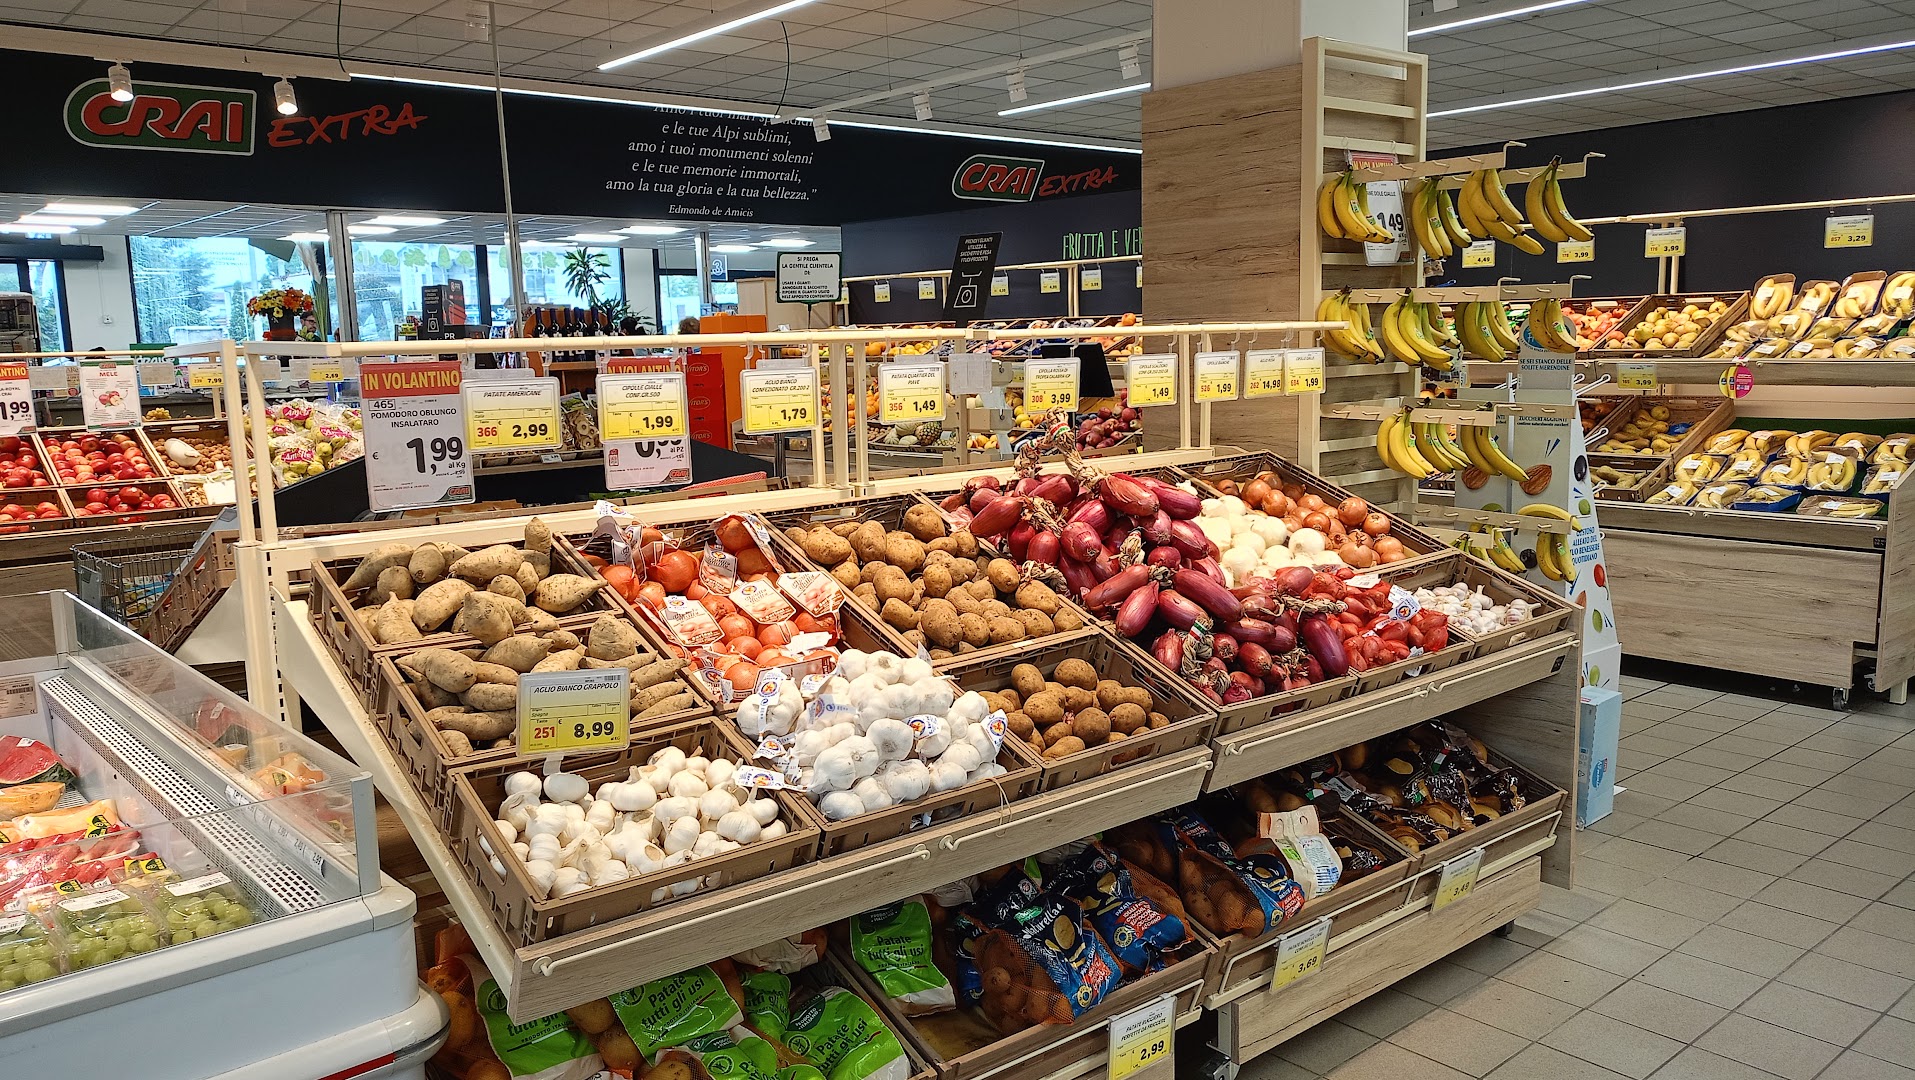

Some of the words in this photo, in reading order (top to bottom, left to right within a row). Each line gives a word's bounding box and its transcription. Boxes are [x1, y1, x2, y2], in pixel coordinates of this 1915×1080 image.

[80, 92, 244, 143] CRAI
[267, 102, 428, 148] EXTRA
[662, 124, 670, 134] e
[673, 121, 685, 135] le
[688, 125, 709, 136] tue
[712, 124, 740, 142] Alpi
[743, 127, 792, 146] sublimi,
[628, 143, 656, 153] amo
[669, 142, 695, 155] tuoi
[699, 145, 770, 161] monumenti
[772, 150, 814, 164] solenni
[632, 162, 640, 172] e
[643, 159, 654, 172] le
[659, 162, 679, 174] tue
[682, 165, 737, 178] memorie
[740, 167, 802, 183] immortali,
[960, 163, 1036, 195] CRAI
[1038, 166, 1118, 197] EXTRA
[606, 181, 634, 191] amo
[638, 179, 649, 192] la
[653, 183, 674, 193] tua
[677, 181, 713, 197] gloria
[716, 187, 723, 196] e
[727, 183, 737, 197] la
[741, 187, 759, 198] tua
[668, 204, 710, 216] Edmondo
[712, 205, 722, 216] de
[724, 207, 754, 217] Amicis
[1063, 231, 1105, 261] FRUTTA
[1112, 230, 1119, 257] E
[1847, 235, 1866, 243] 3,29
[364, 373, 379, 391] IN
[382, 370, 460, 390] VOLANTINO
[1262, 379, 1281, 390] 14,98
[1305, 377, 1319, 388] 1,99
[752, 385, 788, 393] CONFEZIONATO
[1152, 387, 1169, 399] 1,49
[1216, 383, 1231, 394] 1,99
[373, 400, 394, 409] 465
[690, 398, 709, 406] ITOR'S
[889, 402, 903, 412] 356
[912, 399, 936, 413] 1,49
[1031, 394, 1044, 403] 308
[1050, 393, 1071, 405] 3,99
[0, 401, 30, 421] 1,99
[370, 410, 418, 420] POMODORO
[419, 408, 457, 417] OBLUNGO
[780, 407, 807, 422] 1,79
[391, 419, 439, 429] INSALATARO
[642, 415, 673, 430] 1,99
[477, 426, 498, 438] 366
[512, 423, 548, 440] 2,99
[372, 451, 379, 460] €
[406, 436, 463, 476] 1,99
[456, 461, 466, 470] Kg
[1573, 536, 1589, 546] ALLEATO
[1579, 542, 1600, 555] BENESSERE
[1572, 552, 1598, 566] QUOTIDIANO
[534, 686, 556, 694] AGLIO
[556, 684, 583, 692] BIANCO
[583, 682, 619, 690] GRAPPOLO
[534, 726, 555, 740] 251
[573, 720, 615, 740] 8,99
[876, 935, 912, 946] Patate
[867, 946, 890, 961] tutti
[891, 945, 906, 962] gli
[910, 943, 924, 958] usi
[1298, 956, 1317, 973] 3,69
[647, 973, 687, 1008] Patate
[641, 1004, 671, 1030] tutti
[672, 993, 688, 1014] gli
[688, 976, 705, 999] usi
[507, 1016, 540, 1037] tutti
[851, 1017, 869, 1043] usi
[816, 1022, 850, 1056] Patate
[1140, 1040, 1164, 1061] 2,99
